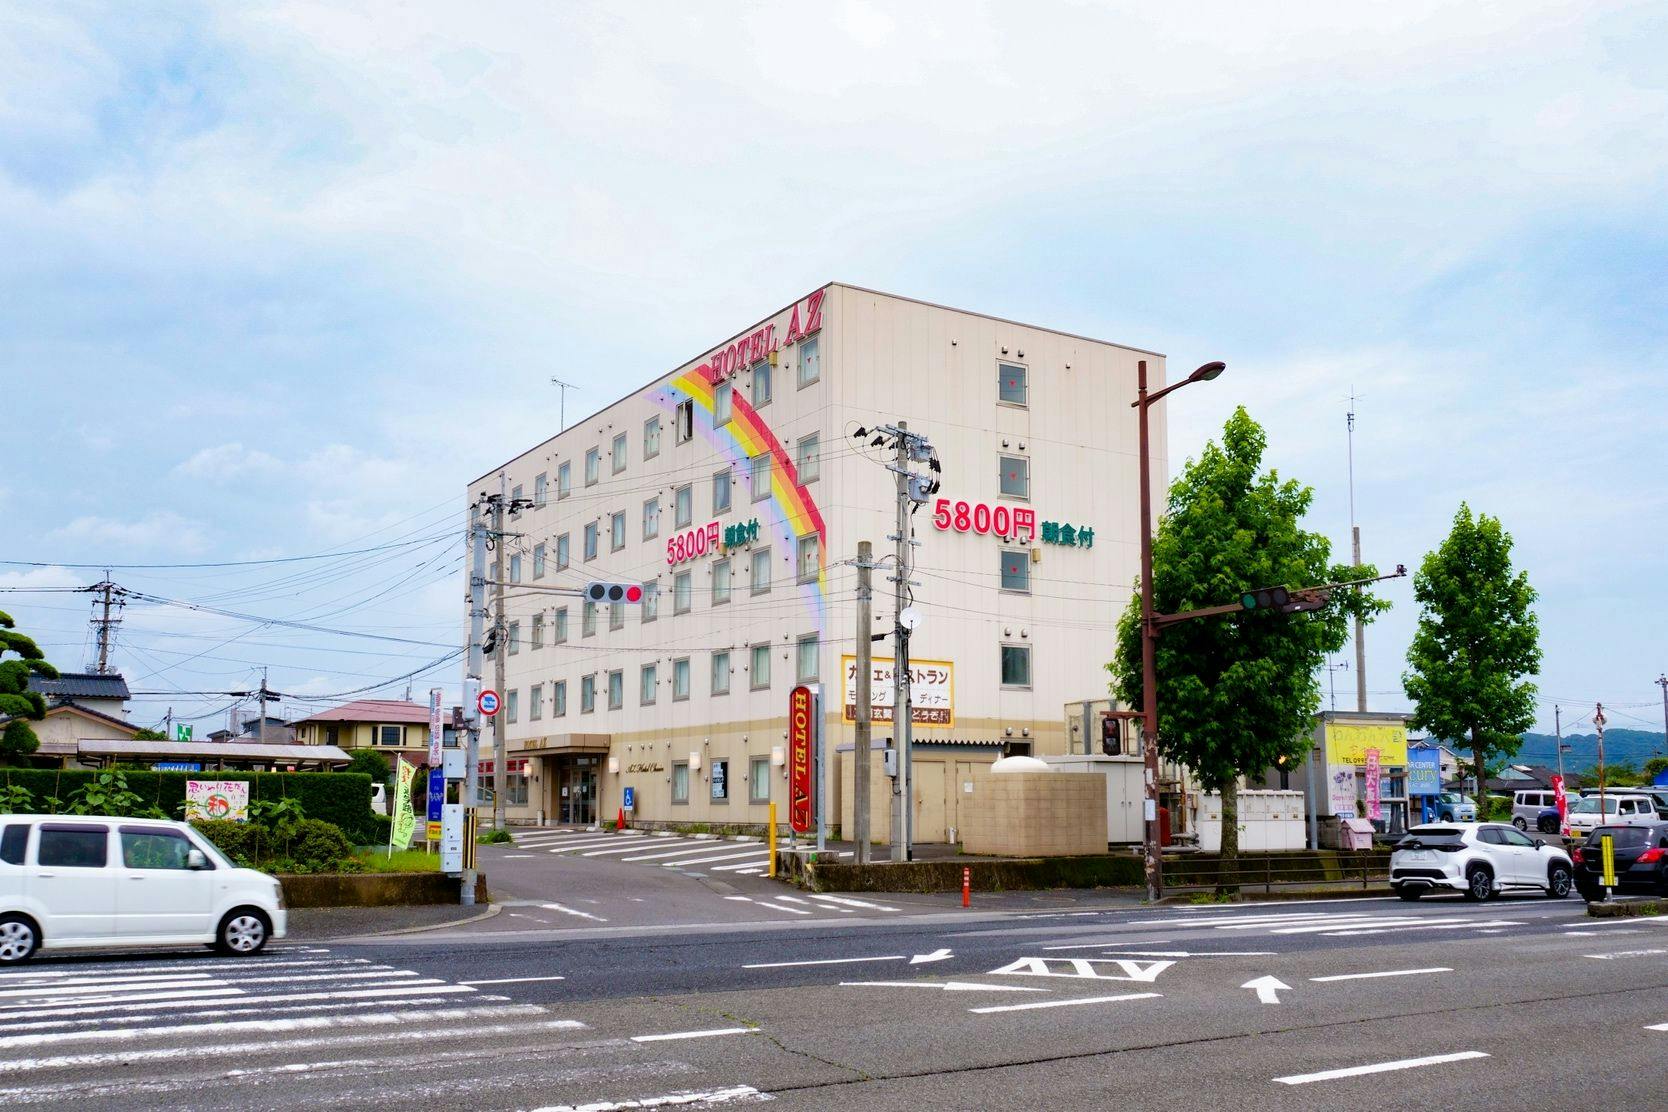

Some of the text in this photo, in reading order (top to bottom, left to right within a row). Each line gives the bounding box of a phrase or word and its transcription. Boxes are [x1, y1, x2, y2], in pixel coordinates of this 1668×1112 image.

[709, 289, 826, 387] HOTEL AZ
[933, 498, 1096, 549] 5800円 朝食付
[666, 517, 760, 567] 5800円 朝食付
[848, 665, 949, 685] カェ&ストラン
[848, 690, 949, 704] モング ディナー
[638, 762, 649, 773] Hotel
[650, 761, 664, 772] Chain
[793, 691, 809, 828] HOTEL AZ
[1415, 761, 1435, 769] CENTER
